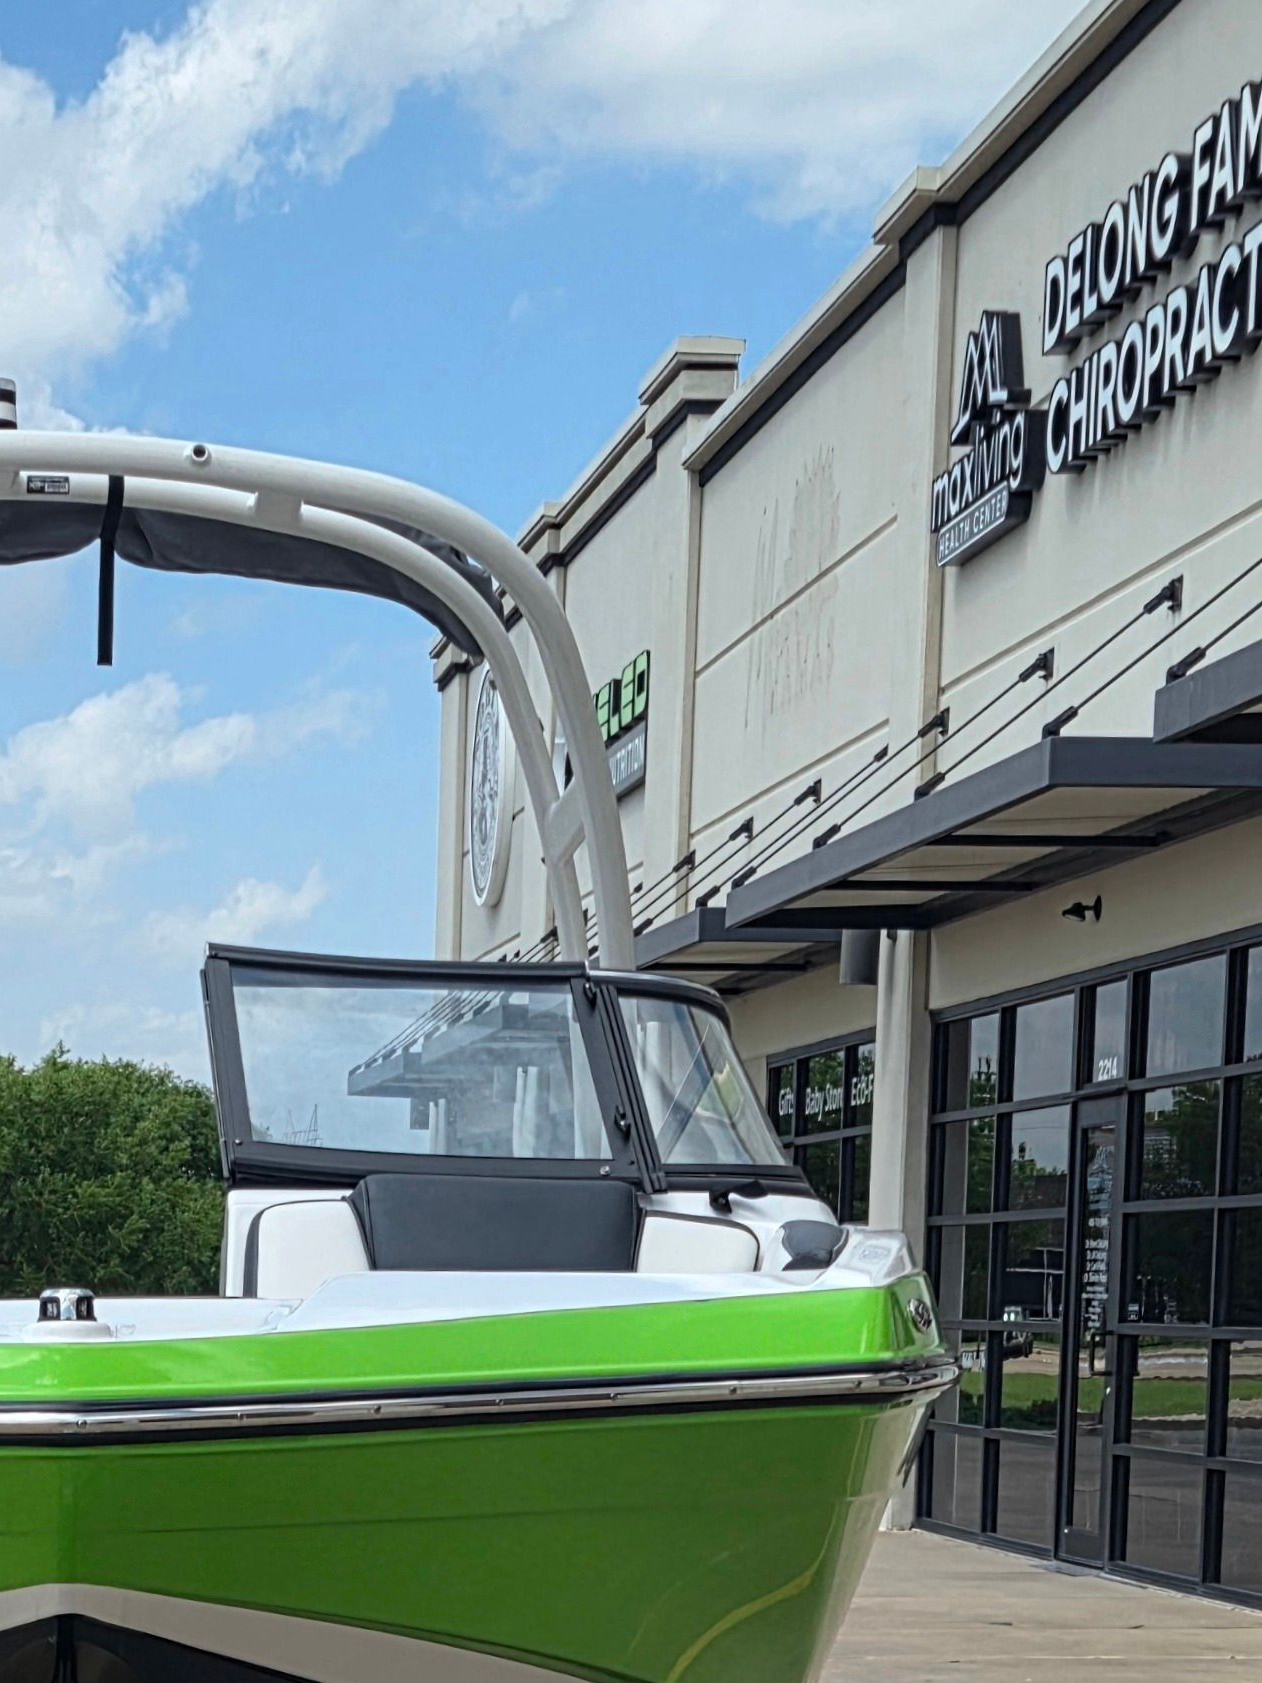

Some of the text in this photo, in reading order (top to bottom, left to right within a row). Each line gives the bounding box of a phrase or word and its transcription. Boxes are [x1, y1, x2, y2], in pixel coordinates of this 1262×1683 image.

[1043, 153, 1179, 352] DELONG
[1046, 221, 1262, 474] CHIROPRACT
[932, 410, 1025, 531] maxliving
[939, 490, 1007, 560] HEALTH CENTER
[608, 732, 645, 786] UTRITION
[851, 1073, 874, 1107] Eco-F
[1098, 1056, 1117, 1081] 2214
[805, 1087, 825, 1121] Baby
